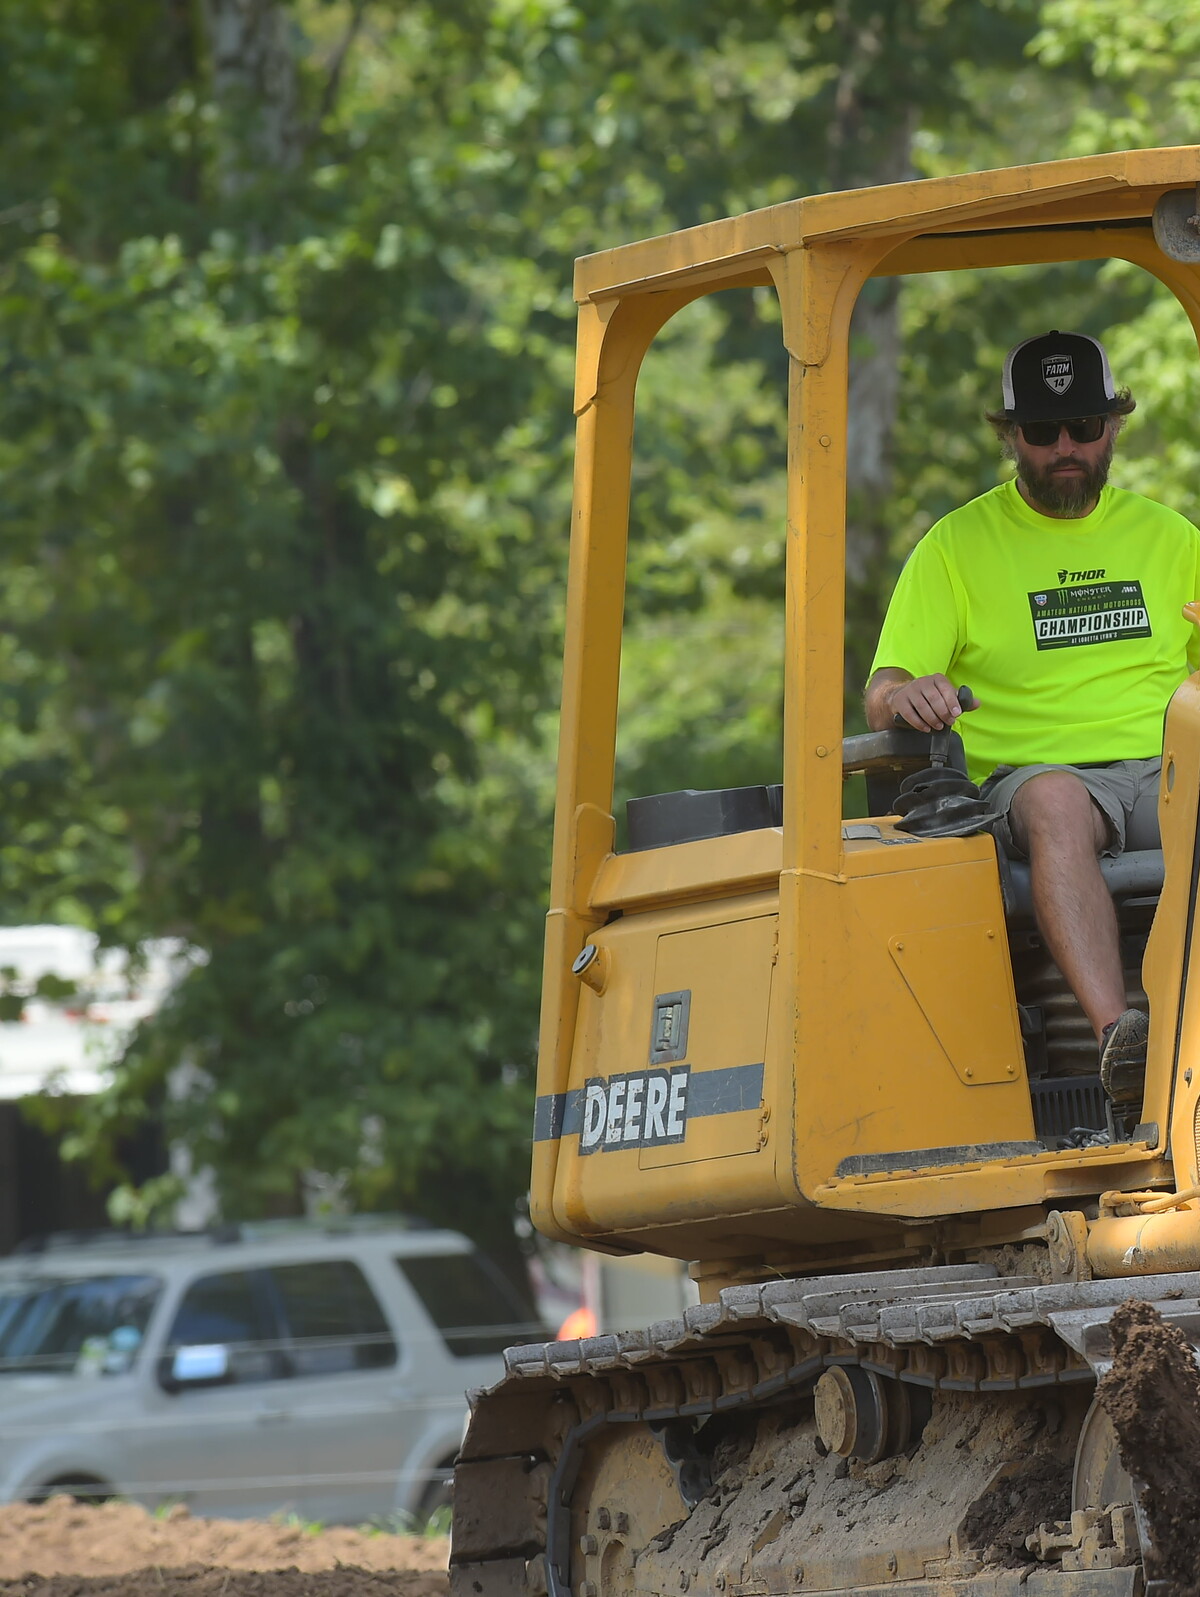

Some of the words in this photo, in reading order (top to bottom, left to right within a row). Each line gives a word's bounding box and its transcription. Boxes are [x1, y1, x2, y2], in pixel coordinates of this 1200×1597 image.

[1046, 362, 1070, 376] FARM
[1053, 378, 1065, 388] 14
[1069, 569, 1106, 582] THOR
[1036, 606, 1066, 617] AMATEUR
[1068, 604, 1100, 615] NATIONAL
[1103, 598, 1142, 609] MOTOCROSS
[1039, 610, 1144, 637] CHAMPIONSHIP
[581, 1072, 688, 1148] DEERE
